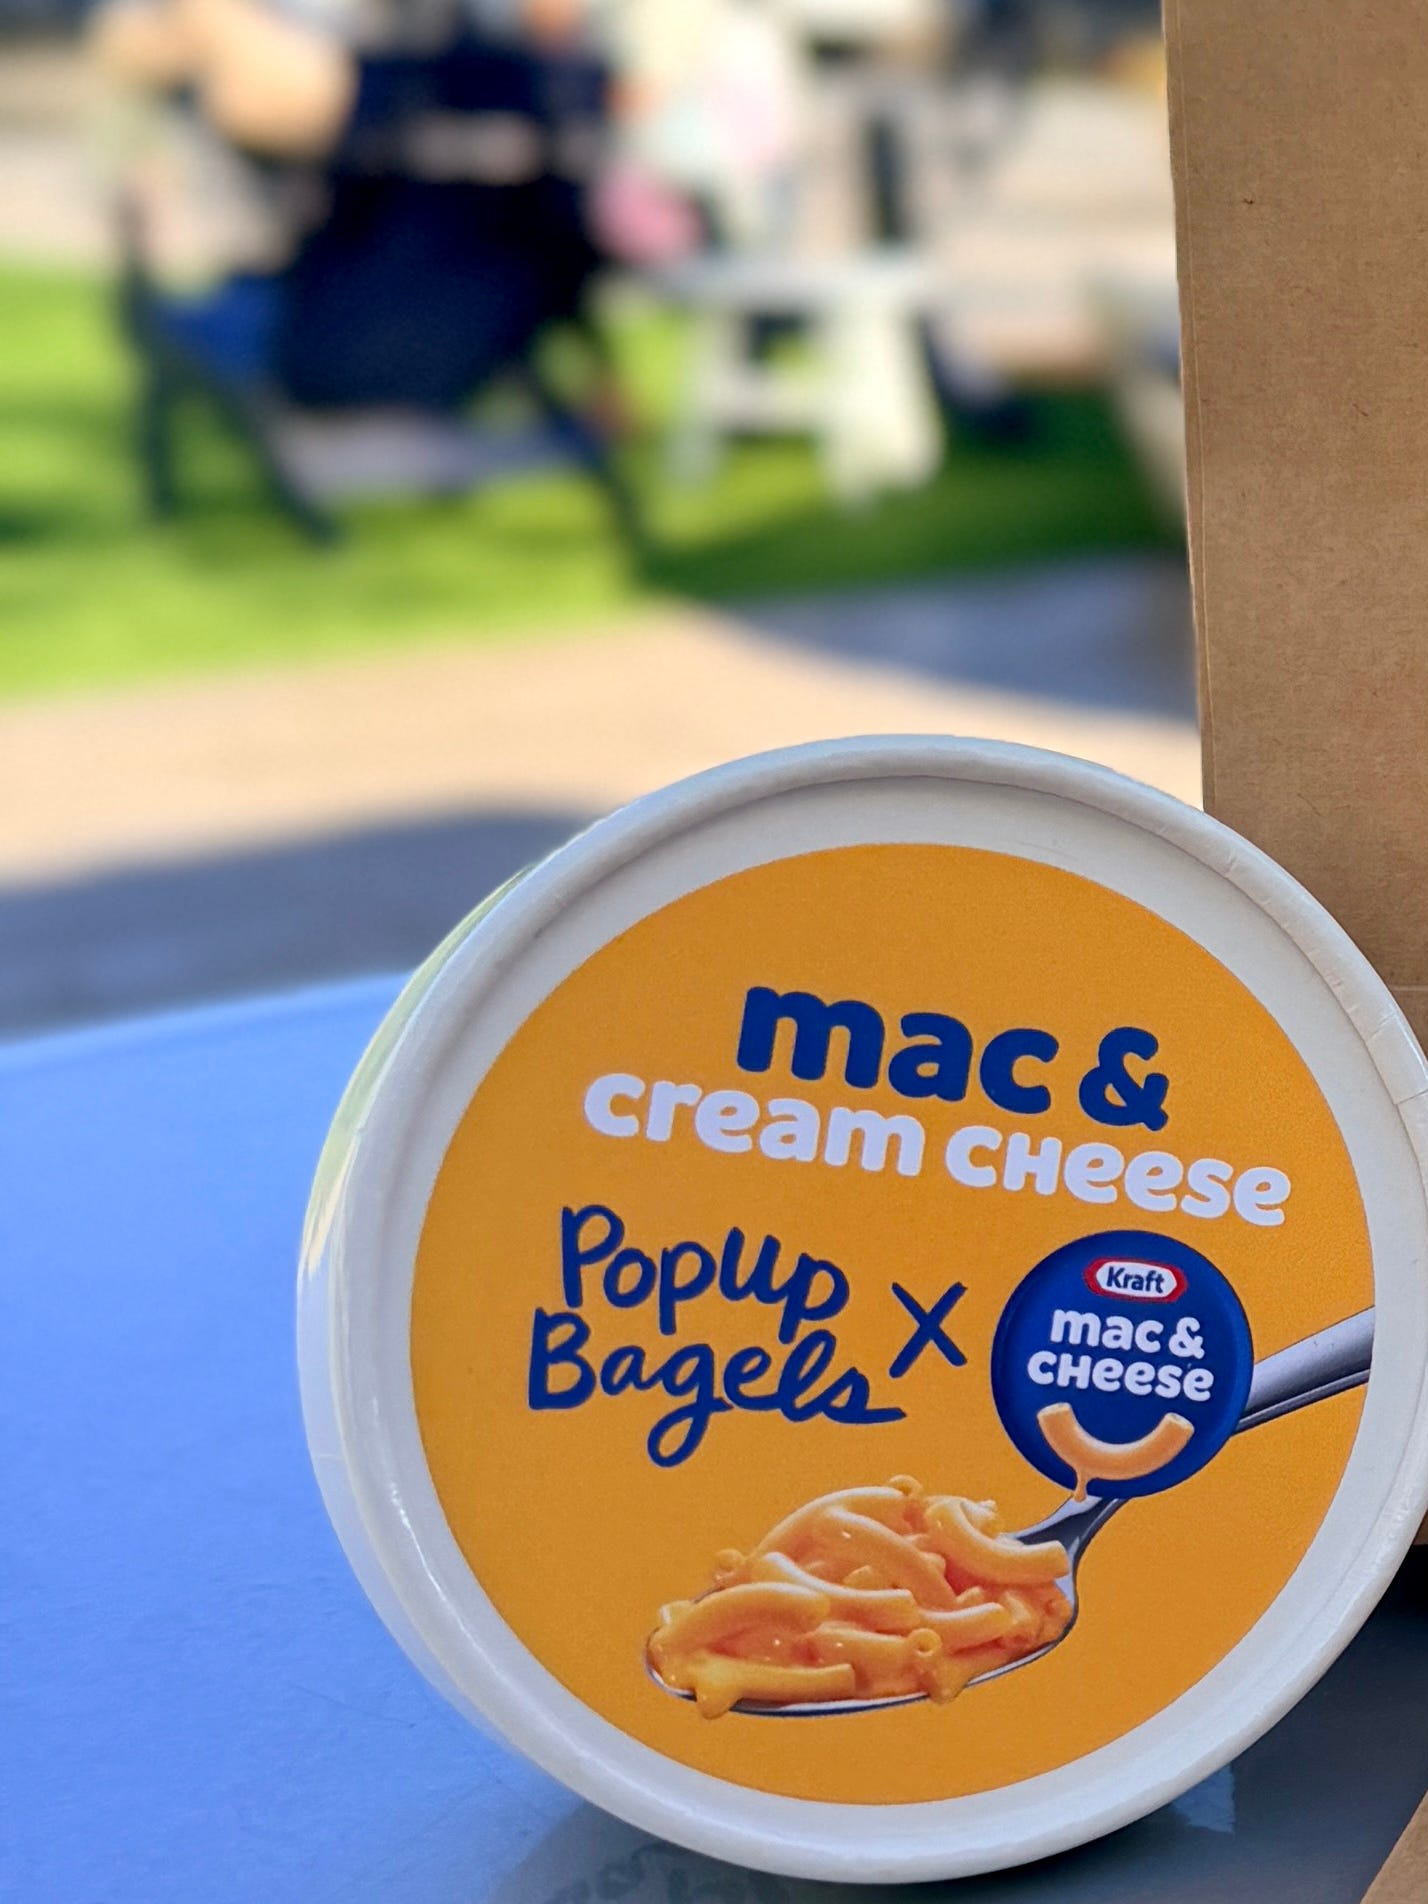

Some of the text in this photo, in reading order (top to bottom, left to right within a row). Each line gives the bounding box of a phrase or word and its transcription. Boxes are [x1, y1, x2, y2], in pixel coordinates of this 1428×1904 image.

[736, 987, 1168, 1132] mac &
[583, 1073, 925, 1177] cream
[1106, 1266, 1165, 1294] Kraft
[1051, 1310, 1205, 1360] mac &
[527, 1309, 905, 1468] Bagels
